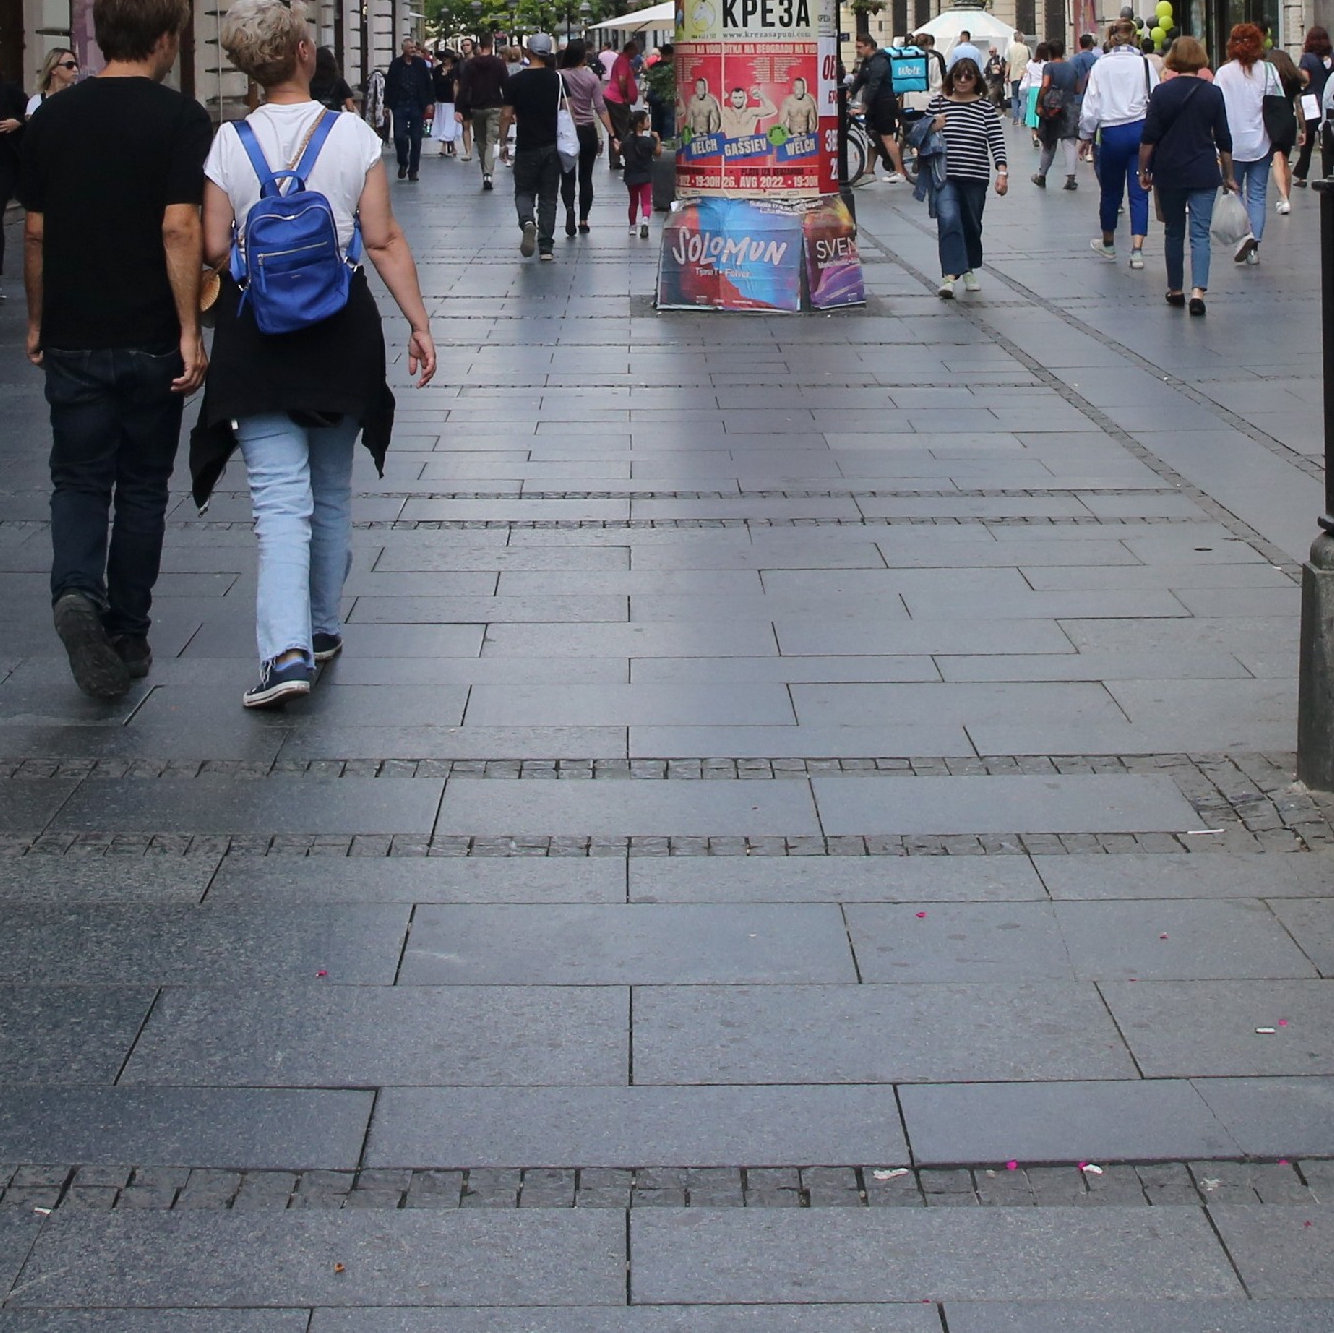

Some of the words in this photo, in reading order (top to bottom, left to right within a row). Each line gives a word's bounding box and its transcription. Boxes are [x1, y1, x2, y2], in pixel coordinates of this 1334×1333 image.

[897, 65, 921, 76] Wolt
[724, 137, 767, 157] GASSIEV
[785, 137, 816, 156] WELCH
[740, 176, 757, 187] AVG
[759, 176, 787, 187] 2022.
[672, 226, 787, 266] SOLOMUN
